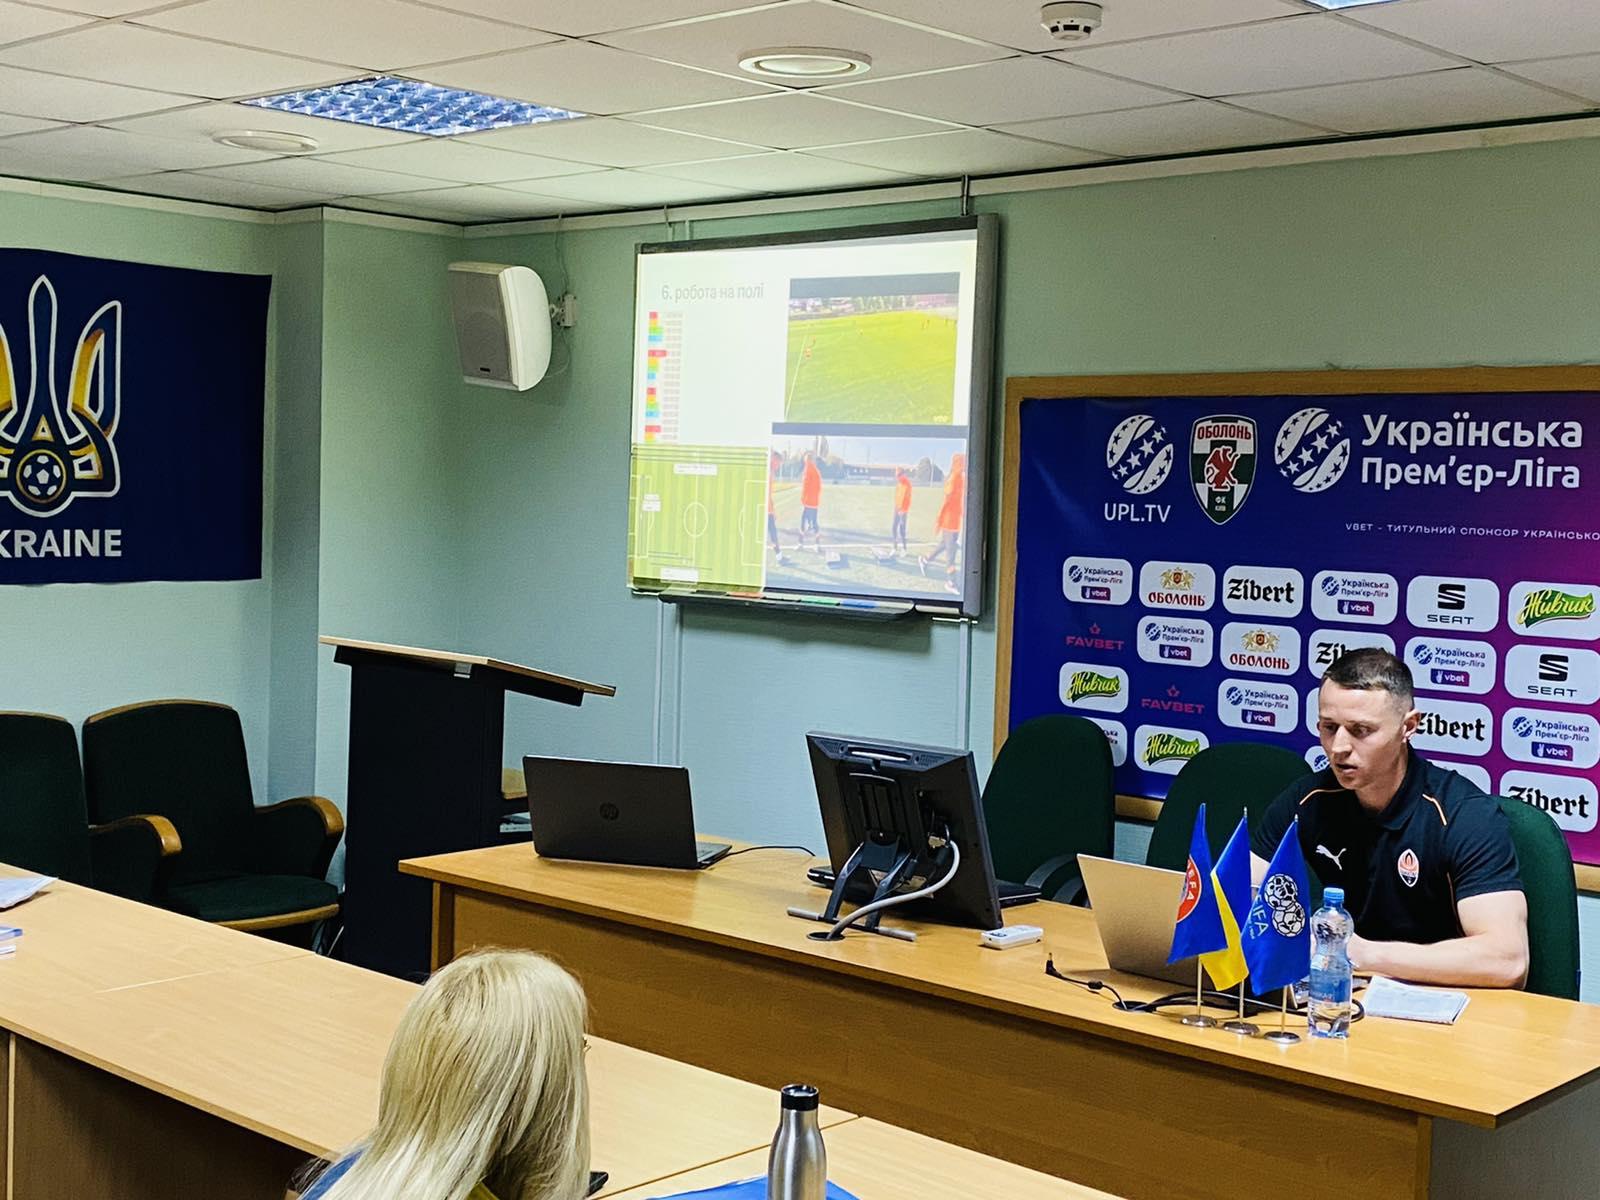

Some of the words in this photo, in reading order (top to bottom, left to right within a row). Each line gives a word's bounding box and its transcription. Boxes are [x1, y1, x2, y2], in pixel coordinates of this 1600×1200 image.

[675, 284, 717, 303] робота
[719, 286, 734, 299] на
[737, 282, 765, 298] полі
[1197, 424, 1252, 440] ОБОЛОНЬ
[1361, 411, 1583, 454] Українська
[1361, 455, 1581, 493] Прем'єр-Ліга
[1104, 503, 1171, 523] UPL.TV
[1345, 523, 1374, 531] VBET
[1387, 524, 1456, 535] ТИТУЛЬНИЙ
[1460, 527, 1519, 537] СПОНСОР
[1227, 578, 1295, 604] Zibert
[1341, 578, 1390, 590] Українська
[1091, 589, 1108, 598] vbet
[1148, 591, 1205, 607] ОБОЛОНЬ
[1350, 604, 1370, 612] vbet
[1427, 614, 1475, 625] SEAT
[1065, 635, 1125, 651] FAVBET
[1171, 649, 1188, 657] vbet
[1434, 646, 1486, 660] Українська
[1229, 653, 1290, 670] ОБОЛОНЬ
[1444, 673, 1465, 683] vbet
[1527, 685, 1578, 698] SEAT
[1141, 698, 1205, 714] FAVBET
[1535, 719, 1590, 733] Українська
[1545, 747, 1568, 757] vbet
